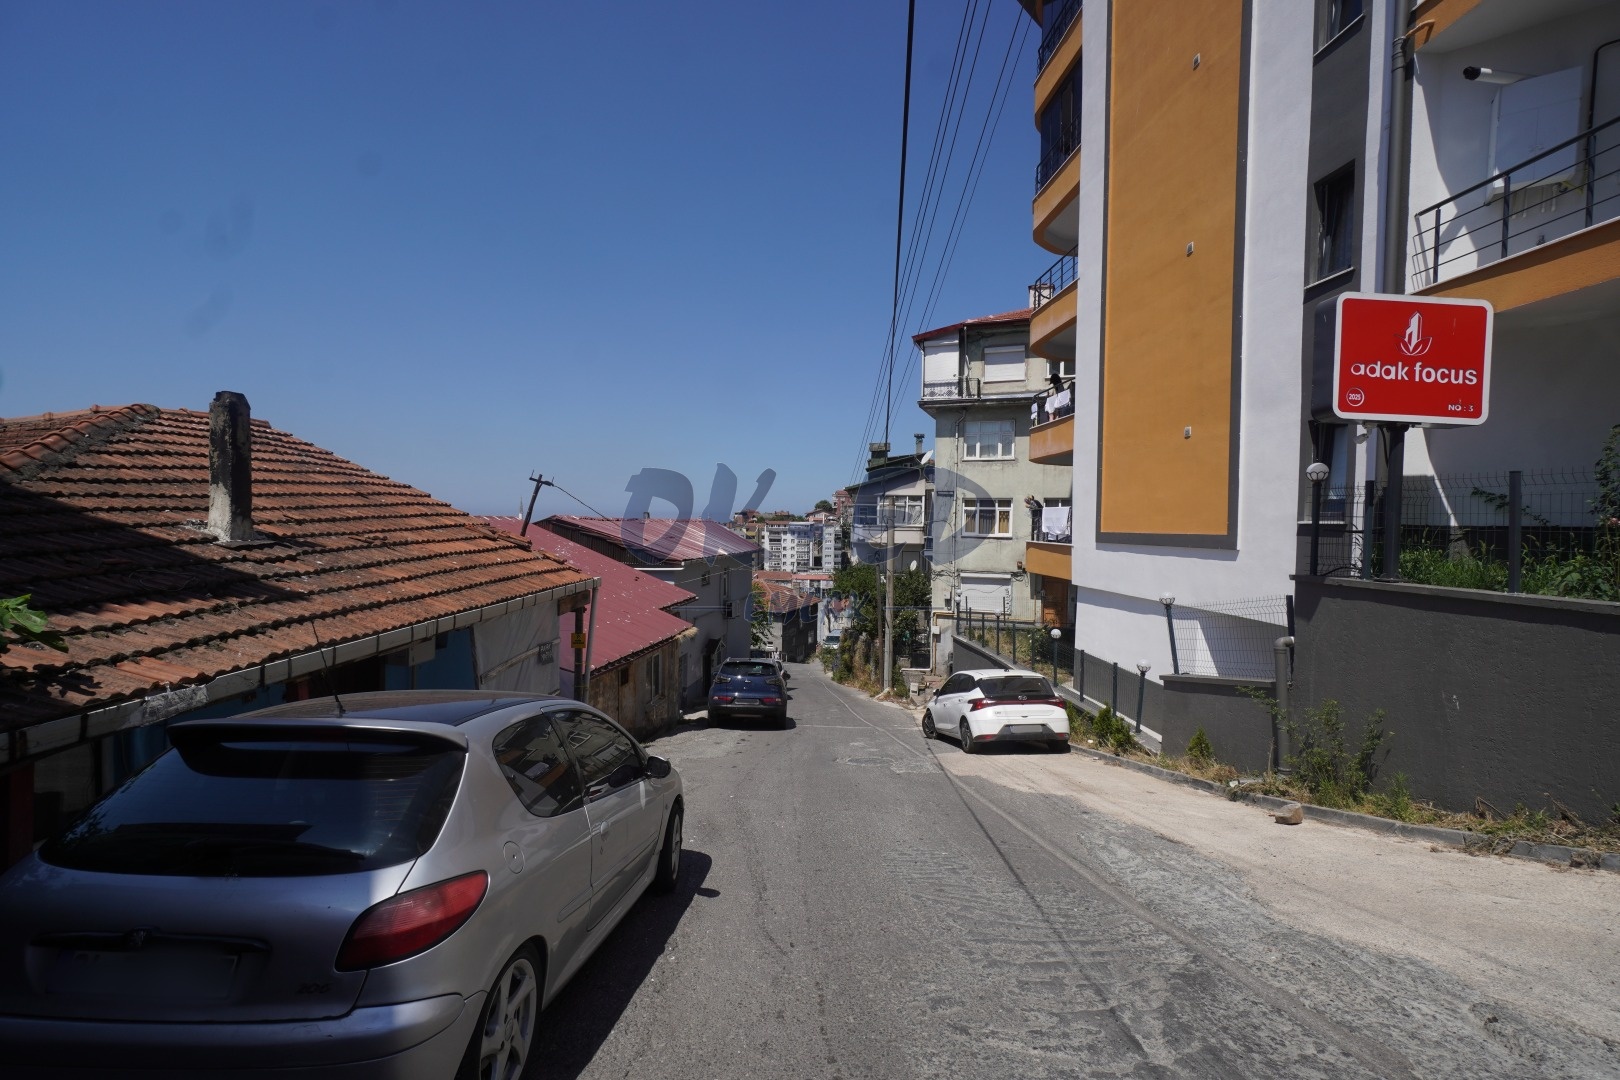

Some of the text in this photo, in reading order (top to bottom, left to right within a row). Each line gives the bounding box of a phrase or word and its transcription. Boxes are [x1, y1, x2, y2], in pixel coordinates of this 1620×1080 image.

[1350, 360, 1478, 385] adak focus
[1348, 393, 1362, 401] 2025
